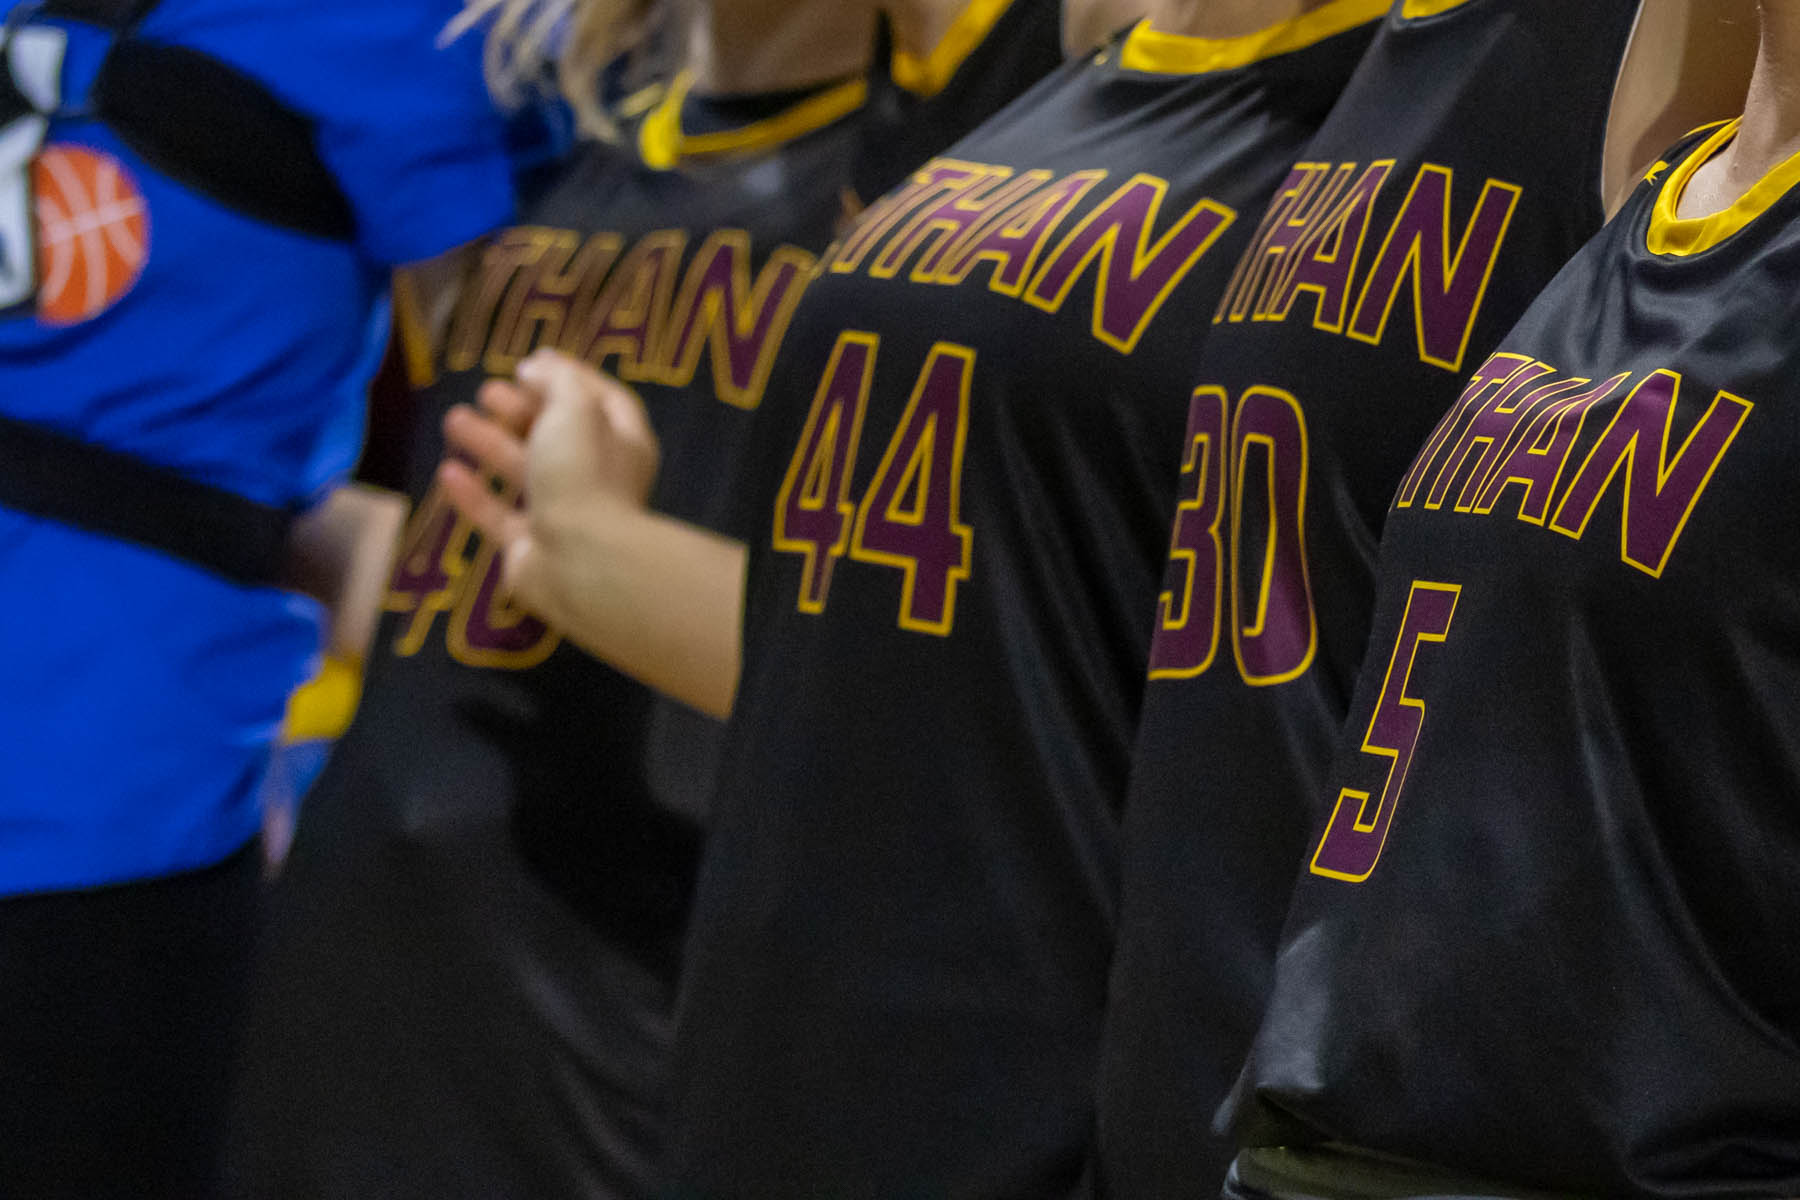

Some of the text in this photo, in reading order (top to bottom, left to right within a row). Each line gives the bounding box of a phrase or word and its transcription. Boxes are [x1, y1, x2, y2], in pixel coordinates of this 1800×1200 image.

[815, 157, 1237, 354] THAN
[773, 331, 977, 636] 44
[1148, 385, 1317, 686] 30
[1388, 351, 1754, 578] THAN
[1310, 580, 1462, 883] 5
